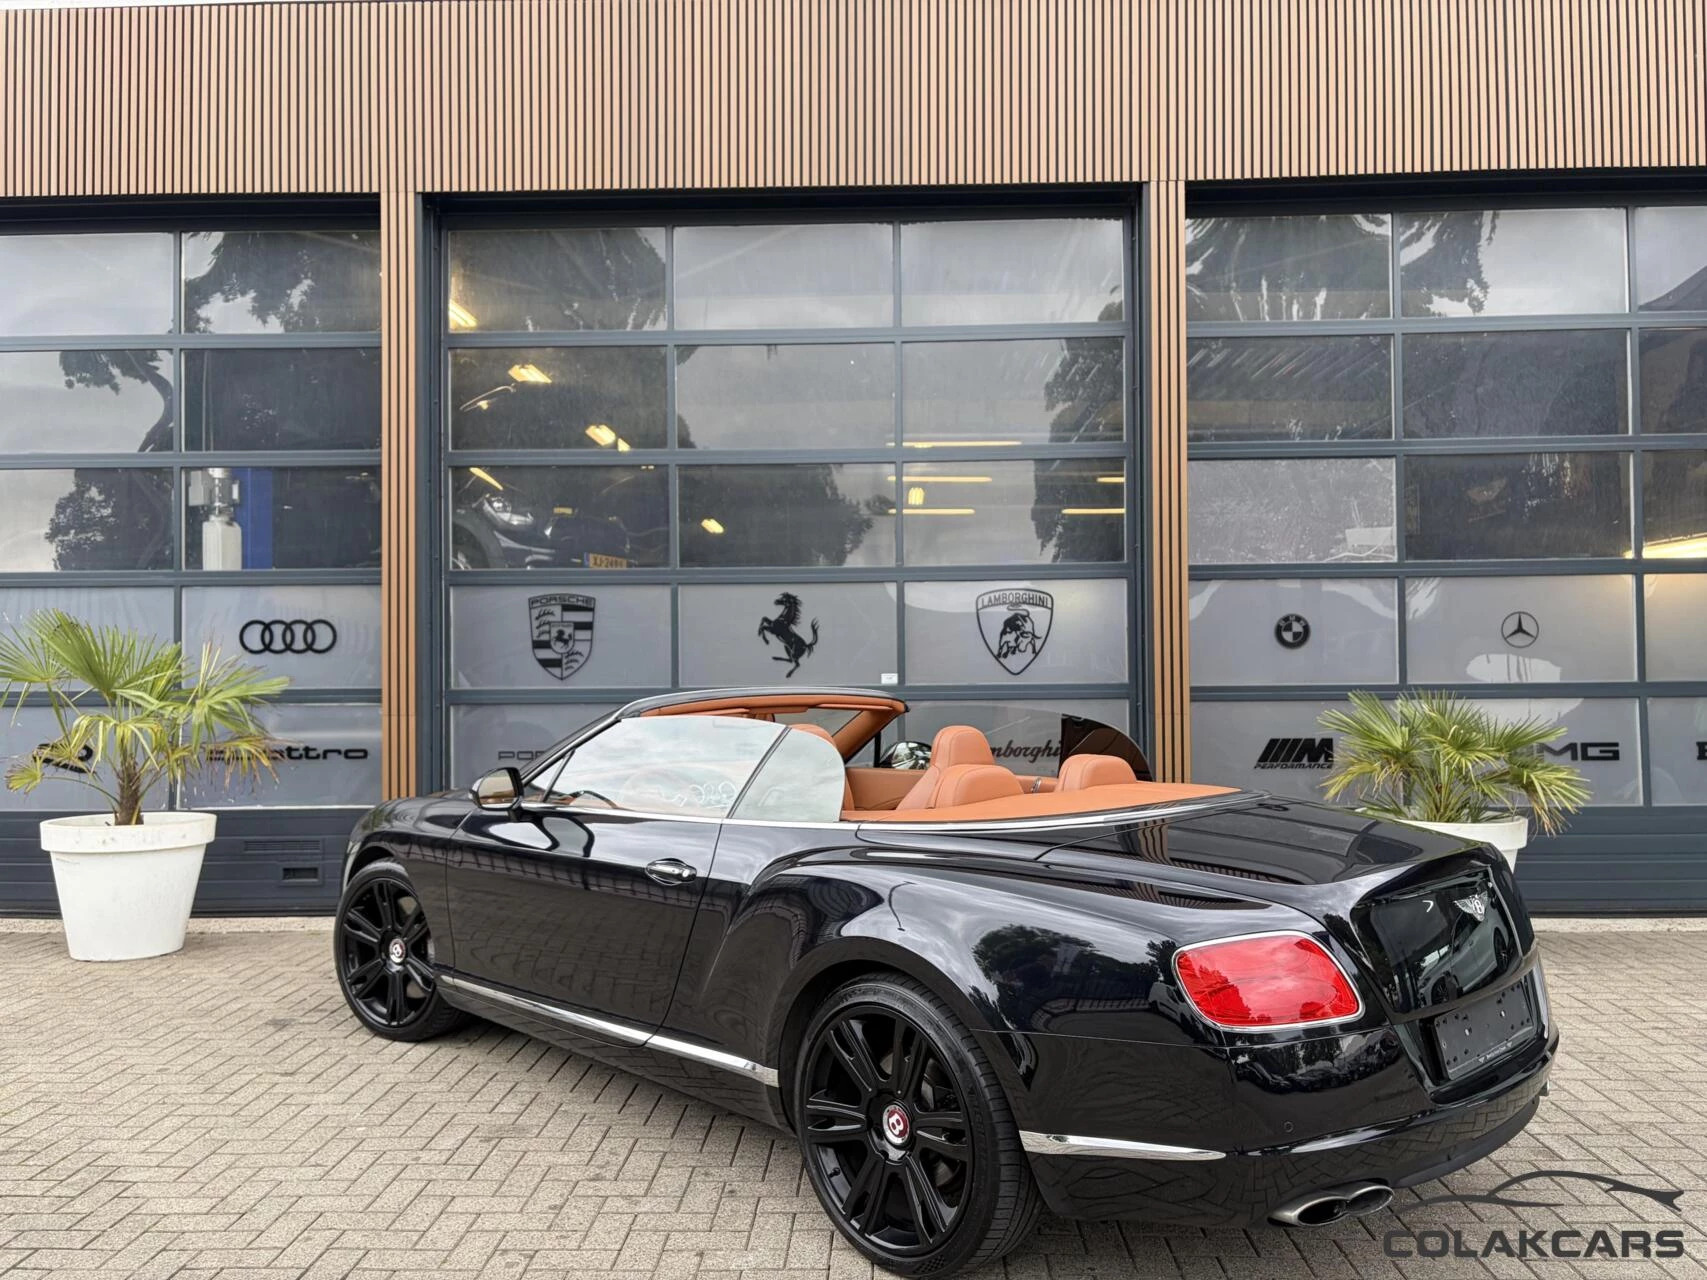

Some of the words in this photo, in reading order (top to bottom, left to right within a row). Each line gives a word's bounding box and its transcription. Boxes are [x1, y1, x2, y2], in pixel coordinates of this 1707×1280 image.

[531, 595, 593, 606] PORSCHE
[981, 592, 1048, 609] LAMBORGHINI
[1512, 741, 1620, 761] MG
